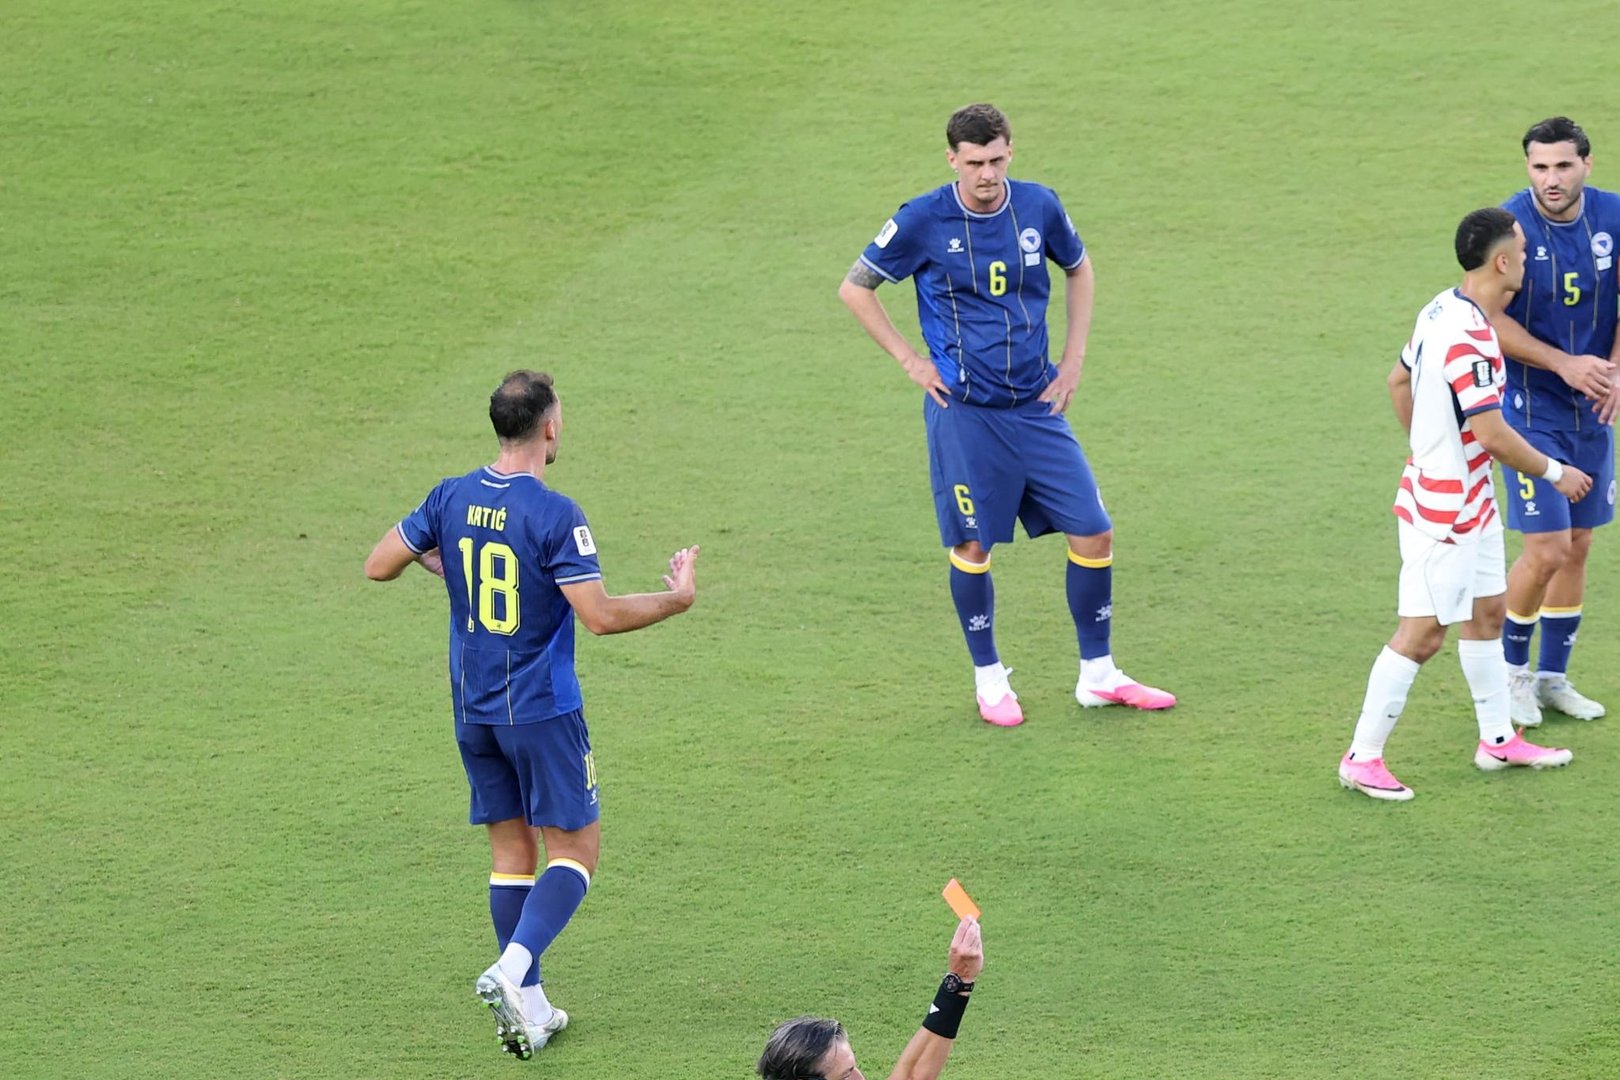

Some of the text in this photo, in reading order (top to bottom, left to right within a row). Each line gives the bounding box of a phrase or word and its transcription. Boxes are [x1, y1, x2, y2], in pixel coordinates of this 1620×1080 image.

[989, 261, 1006, 296] 6
[1563, 272, 1580, 306] 5
[953, 483, 975, 516] 6
[466, 504, 507, 531] KATIĆ
[458, 536, 521, 637] 18
